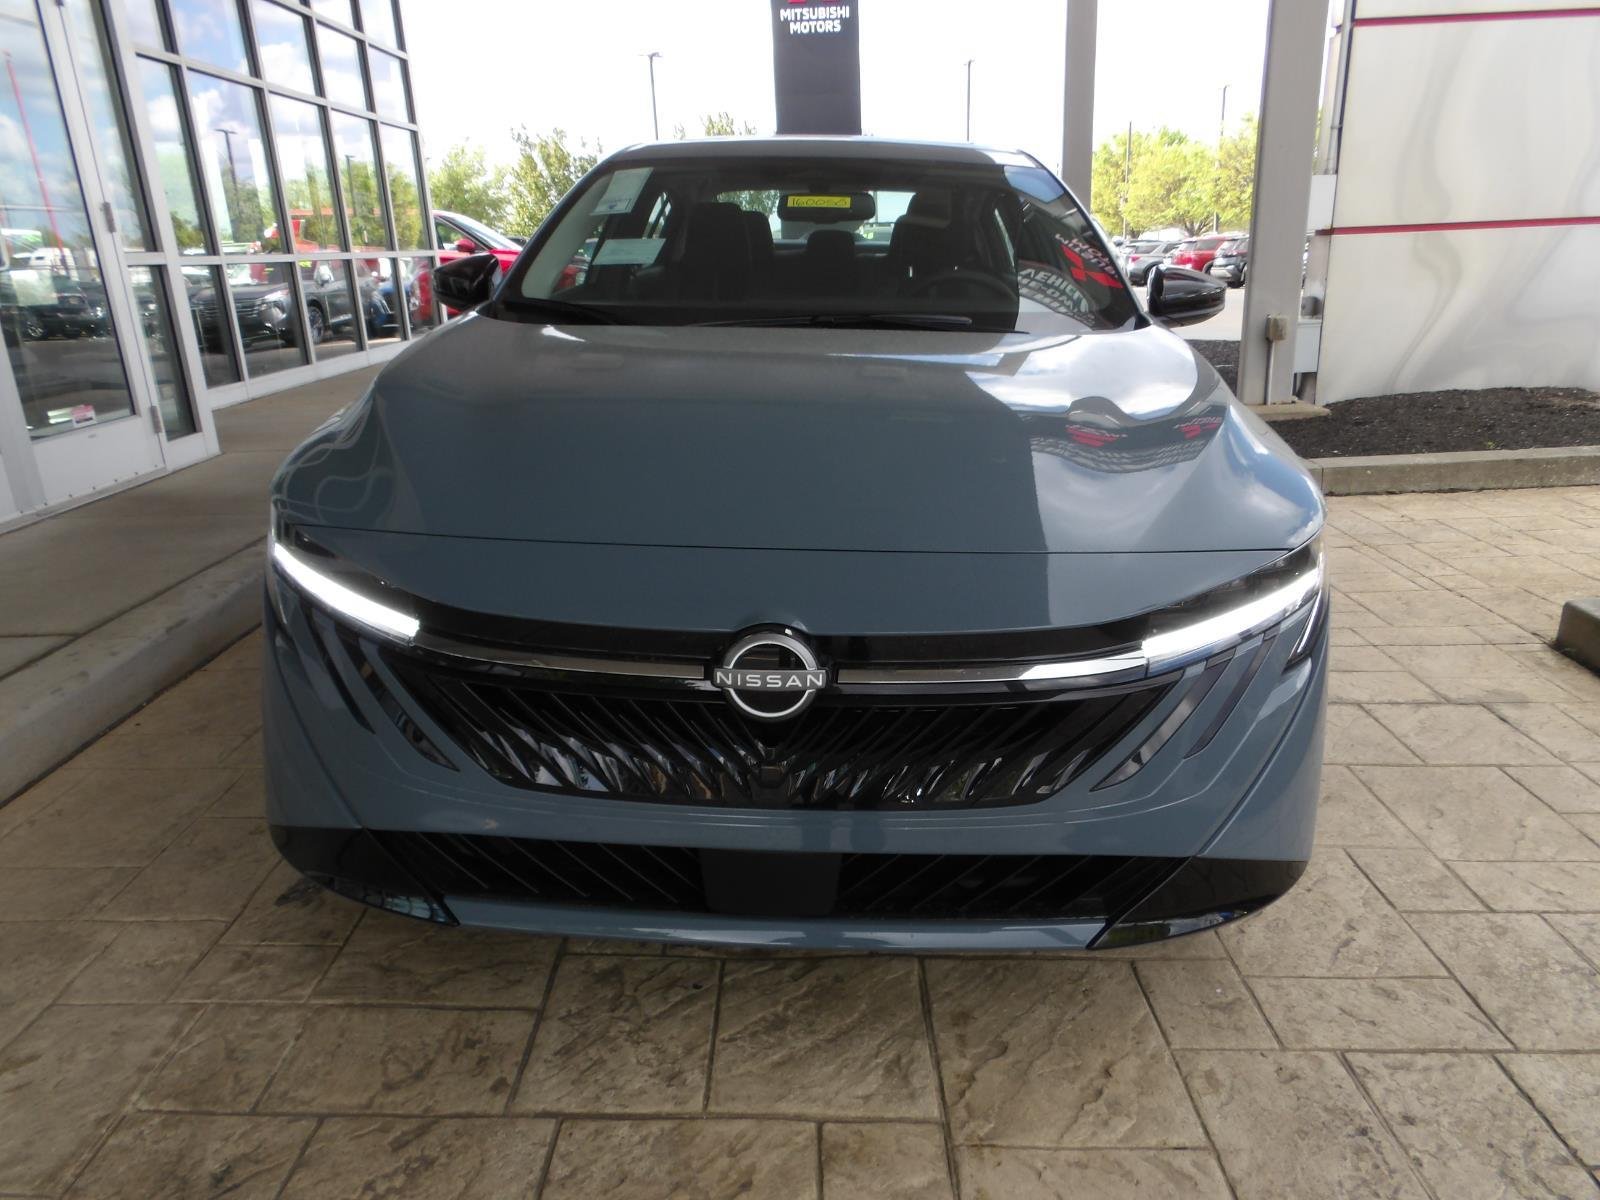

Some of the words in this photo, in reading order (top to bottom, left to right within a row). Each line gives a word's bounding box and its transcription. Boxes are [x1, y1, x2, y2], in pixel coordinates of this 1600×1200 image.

[780, 6, 850, 21] MITSUBISHI
[790, 20, 841, 34] MOTORS
[716, 671, 823, 688] NISSAN
